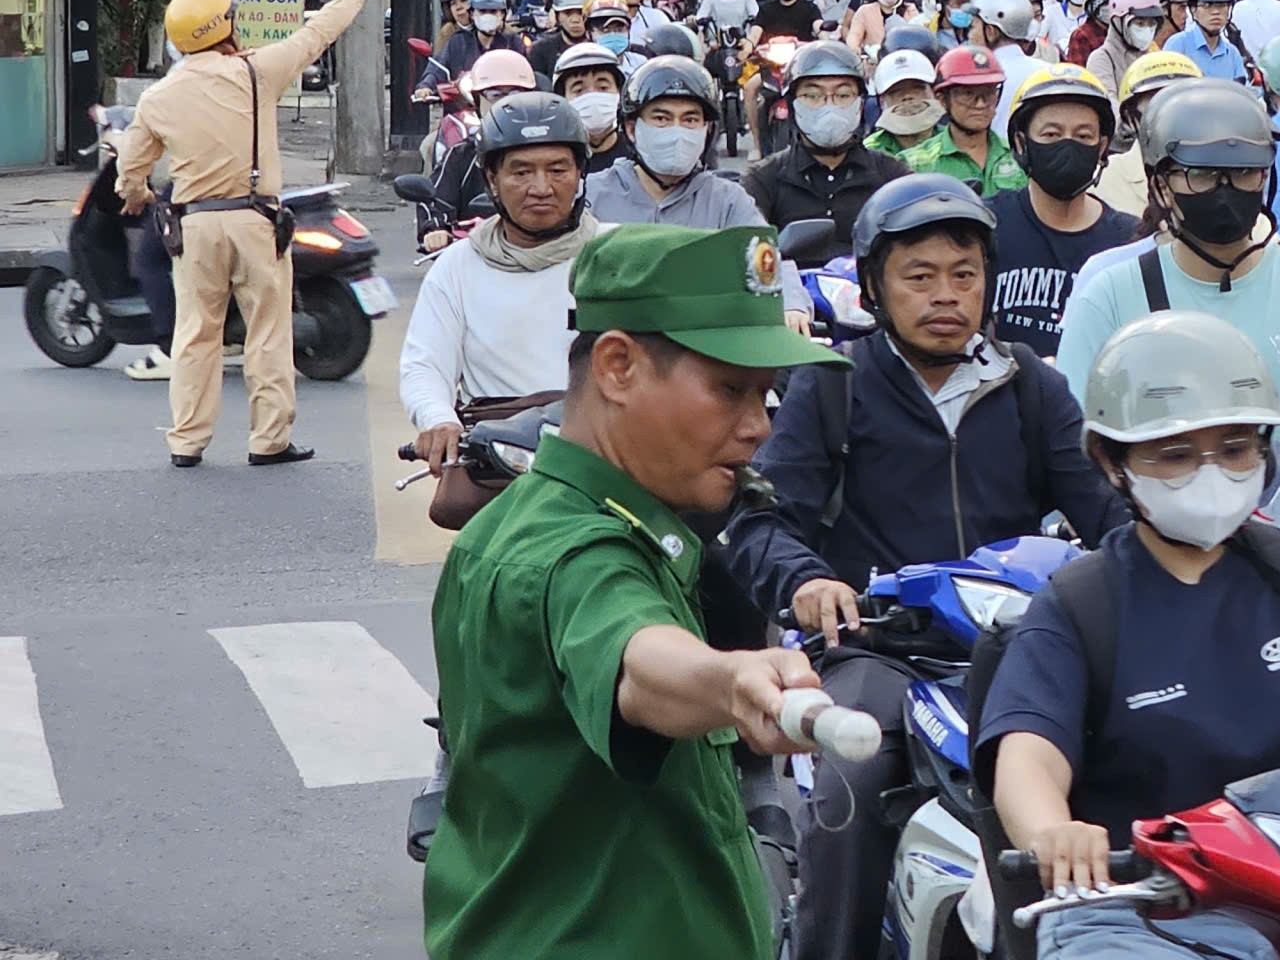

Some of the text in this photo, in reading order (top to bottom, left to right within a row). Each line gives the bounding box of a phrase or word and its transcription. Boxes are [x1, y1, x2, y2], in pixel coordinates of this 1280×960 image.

[992, 266, 1066, 313] TOMMY
[1005, 312, 1065, 335] NEW YOR
[913, 699, 946, 748] YAMAHA
